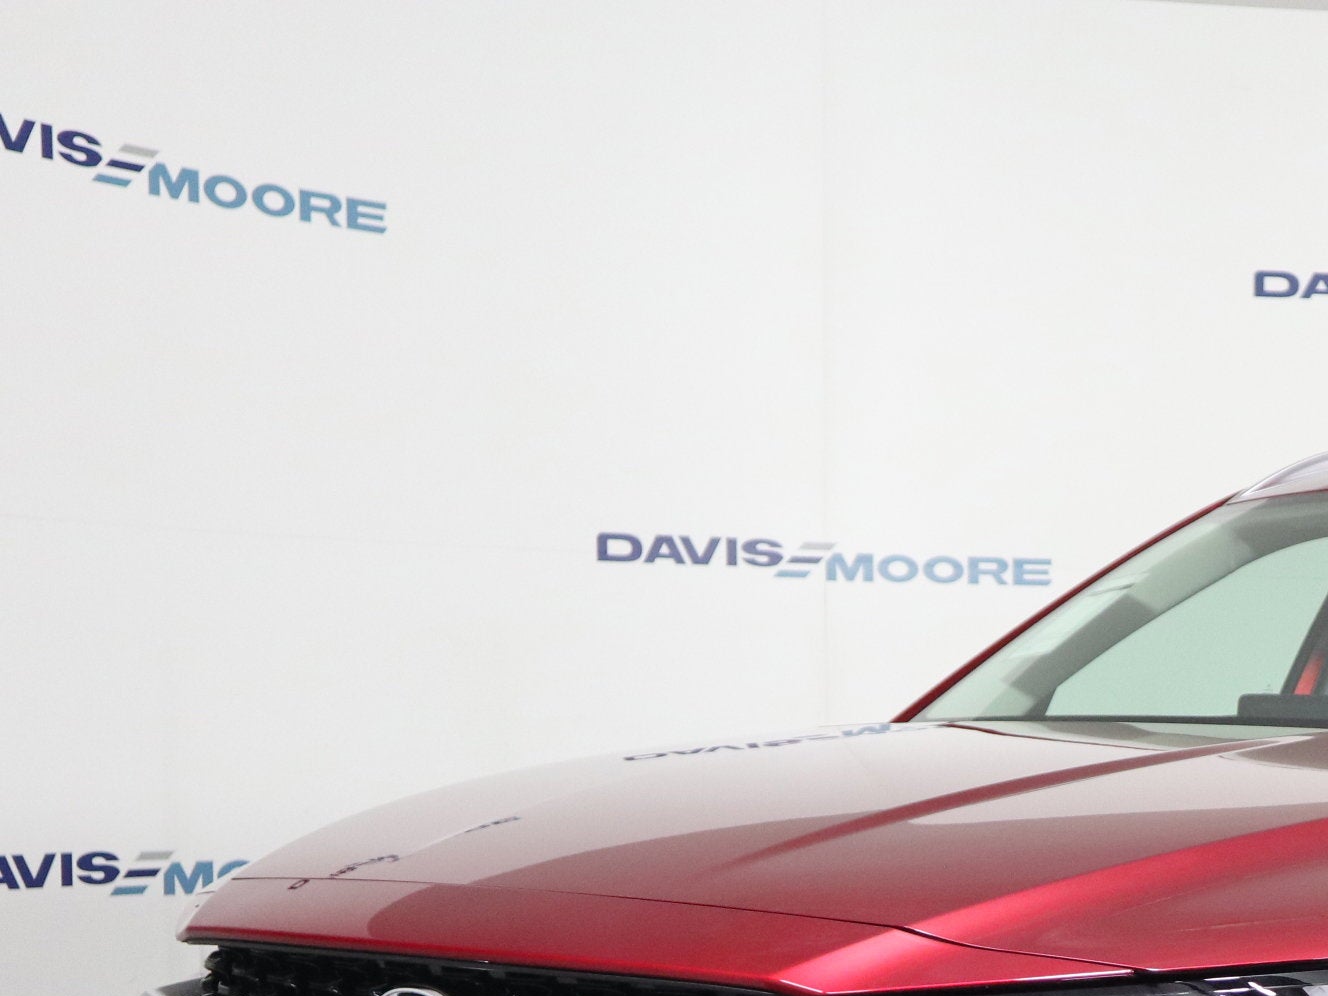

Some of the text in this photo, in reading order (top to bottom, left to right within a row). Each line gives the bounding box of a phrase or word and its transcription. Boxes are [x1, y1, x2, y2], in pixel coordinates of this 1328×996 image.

[0, 113, 387, 234] VIS MOORE
[596, 532, 1053, 586] DAVIS MOORE
